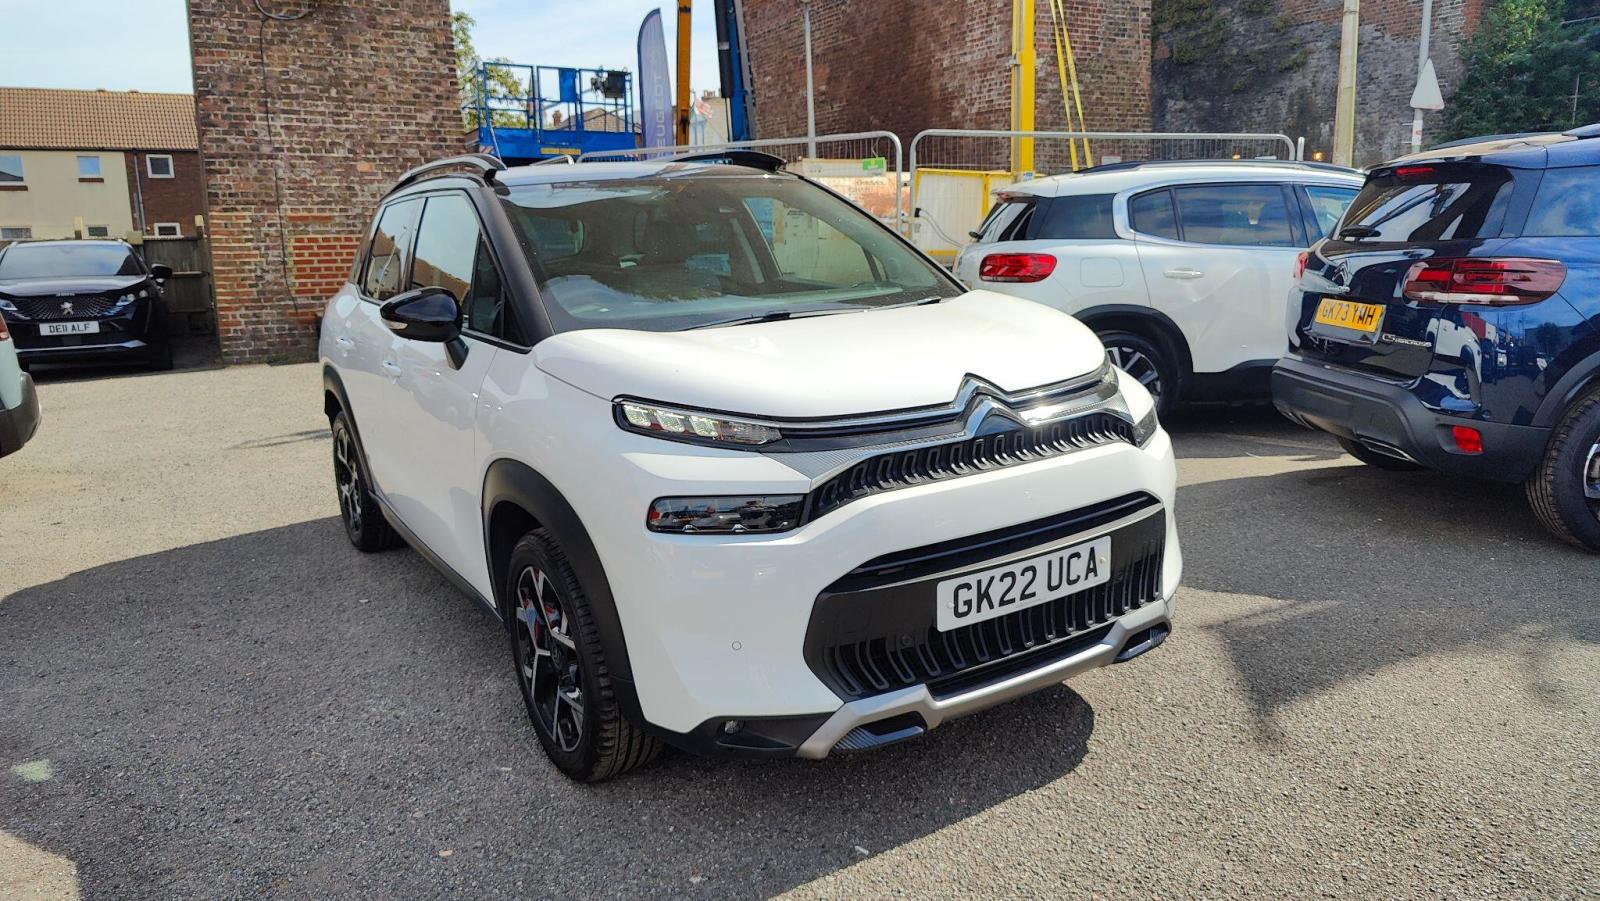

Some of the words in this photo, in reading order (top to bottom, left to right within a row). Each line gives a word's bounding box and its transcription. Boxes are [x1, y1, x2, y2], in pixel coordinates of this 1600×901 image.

[1322, 301, 1350, 321] GK73
[71, 323, 91, 332] ALF
[953, 564, 1037, 618] GK22
[1047, 546, 1098, 592] UCA
